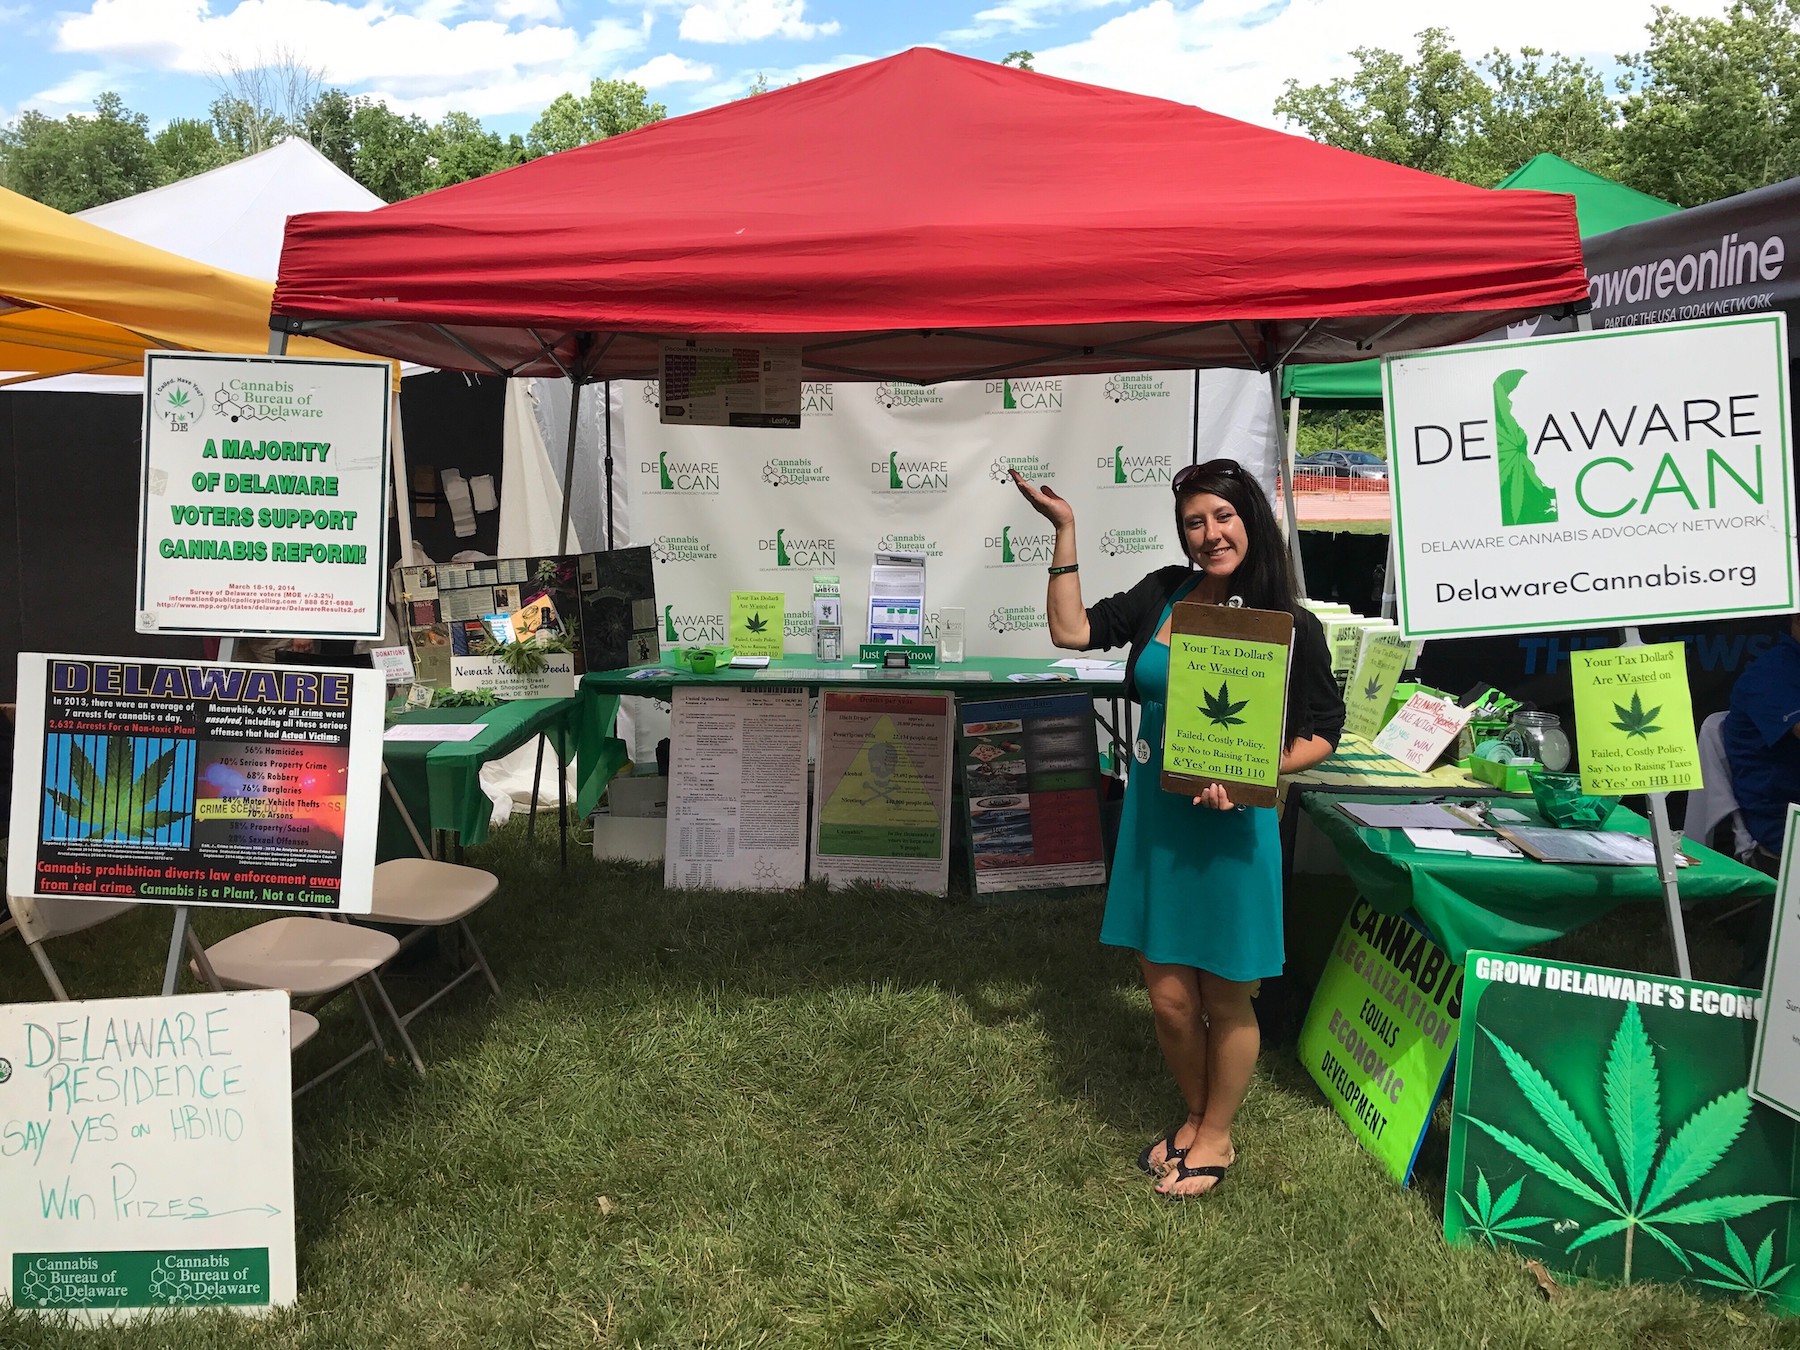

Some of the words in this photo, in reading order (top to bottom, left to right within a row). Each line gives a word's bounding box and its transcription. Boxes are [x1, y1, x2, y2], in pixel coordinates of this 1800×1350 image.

[1605, 317, 1626, 329] PART
[1626, 315, 1638, 327] OF
[1638, 312, 1658, 326] THE
[1658, 308, 1677, 322] USA
[1679, 302, 1714, 320] TODAY
[1713, 292, 1774, 314] NETWORK
[230, 378, 294, 392] Cannabis
[1114, 374, 1152, 382] Cannabis
[1123, 382, 1152, 390] Bureau
[244, 392, 292, 404] Bureau
[296, 394, 312, 406] of
[1132, 390, 1170, 398] Delaware
[258, 405, 323, 418] Delaware
[202, 439, 217, 458] A
[222, 440, 330, 462] MAJORITY
[781, 466, 812, 474] Bureau
[813, 466, 823, 474] of
[790, 474, 830, 482] Delaware
[1130, 468, 1172, 483] CAN
[192, 472, 220, 492] OF
[224, 474, 338, 496] DELAWARE
[677, 474, 720, 490] CAN
[1575, 444, 1764, 518] CAN
[171, 506, 254, 526] VOTERS
[258, 508, 357, 530] SUPPORT
[1421, 536, 1504, 554] DELAWARE
[1508, 530, 1588, 547] CANNABIS
[1592, 522, 1678, 540] ADVOCACY
[1682, 514, 1766, 532] NETWORK
[158, 538, 268, 560] CANNABIS
[272, 542, 367, 564] REFORM!
[1436, 562, 1757, 603] DelawareCannabis.org
[376, 649, 406, 658] DONATIONS
[862, 650, 880, 660] Just
[1182, 642, 1208, 654] Your
[1210, 644, 1230, 656] Tax
[1234, 648, 1274, 662] Dollar$
[1584, 658, 1612, 668] Your
[1615, 656, 1637, 665] Tax
[1640, 650, 1674, 664] Dollar$
[455, 666, 493, 676] Newark
[1186, 660, 1206, 672] Are
[1209, 662, 1248, 676] Wasted
[1251, 670, 1265, 678] on
[52, 660, 349, 706] DELAWARE
[1592, 676, 1613, 686] Are
[1616, 671, 1656, 684] Wasted
[1660, 671, 1672, 680] on
[53, 696, 61, 704] In
[64, 697, 88, 706] 2013,
[92, 698, 113, 708] there
[116, 700, 136, 708] were
[150, 702, 184, 712] average
[186, 702, 196, 711] of
[65, 709, 70, 717] 7
[72, 710, 102, 718] arrests
[104, 711, 116, 719] for
[119, 712, 155, 721] cannabis
[157, 714, 163, 722] a
[165, 713, 182, 724] day.
[50, 720, 74, 730] 2,632
[76, 720, 106, 730] Arrests
[108, 722, 122, 731] For
[124, 724, 130, 732] a
[132, 724, 172, 733] Non-toxic
[174, 724, 196, 734] Plant
[1176, 730, 1204, 742] Failed,
[1208, 734, 1234, 746] Costly
[1237, 738, 1266, 750] Policy.
[1171, 743, 1186, 755] Say
[1188, 746, 1201, 754] No
[1202, 748, 1211, 756] to
[1214, 749, 1242, 762] Raising
[1244, 754, 1270, 764] Taxes
[1592, 748, 1624, 758] Failed,
[1626, 746, 1654, 758] Costly
[1658, 744, 1686, 756] Policy.
[1208, 764, 1221, 772] on
[1224, 764, 1242, 776] HB
[1247, 768, 1265, 778] 110
[37, 860, 92, 874] Cannabis
[96, 864, 161, 878] prohibition
[164, 866, 206, 880] diverts
[209, 868, 230, 882] law
[234, 870, 306, 885] enforcement
[310, 875, 340, 889] away
[40, 878, 68, 891] from
[72, 880, 96, 892] real
[100, 881, 136, 894] crime.
[140, 882, 194, 896] Cannabis
[198, 886, 208, 897] is
[212, 888, 219, 898] a
[224, 886, 258, 900] Plant,
[262, 888, 284, 900] Not
[286, 892, 294, 902] a
[298, 890, 336, 904] Crime.
[1350, 896, 1464, 1019] CANNABIS
[1476, 958, 1542, 988] GROW
[1546, 967, 1684, 1010] DELAWARE'S
[1337, 936, 1451, 1050] LEGALIZATION
[1360, 998, 1400, 1048] EQUALS
[24, 1008, 232, 1068] DELAWARE
[1328, 1008, 1404, 1104] ECONOMIC
[1320, 1050, 1388, 1142] DEVELOPMENT
[2, 1118, 51, 1166] SAY
[72, 1114, 118, 1164] YES
[170, 1104, 243, 1142] HB110
[36, 1258, 98, 1270] Cannabis
[164, 1255, 230, 1268] Cannabis
[50, 1272, 97, 1284] Bureau
[100, 1270, 116, 1283] of
[179, 1268, 229, 1282] Bureau
[232, 1268, 248, 1280] of
[65, 1284, 128, 1297] Delaware
[194, 1282, 260, 1295] Delaware
